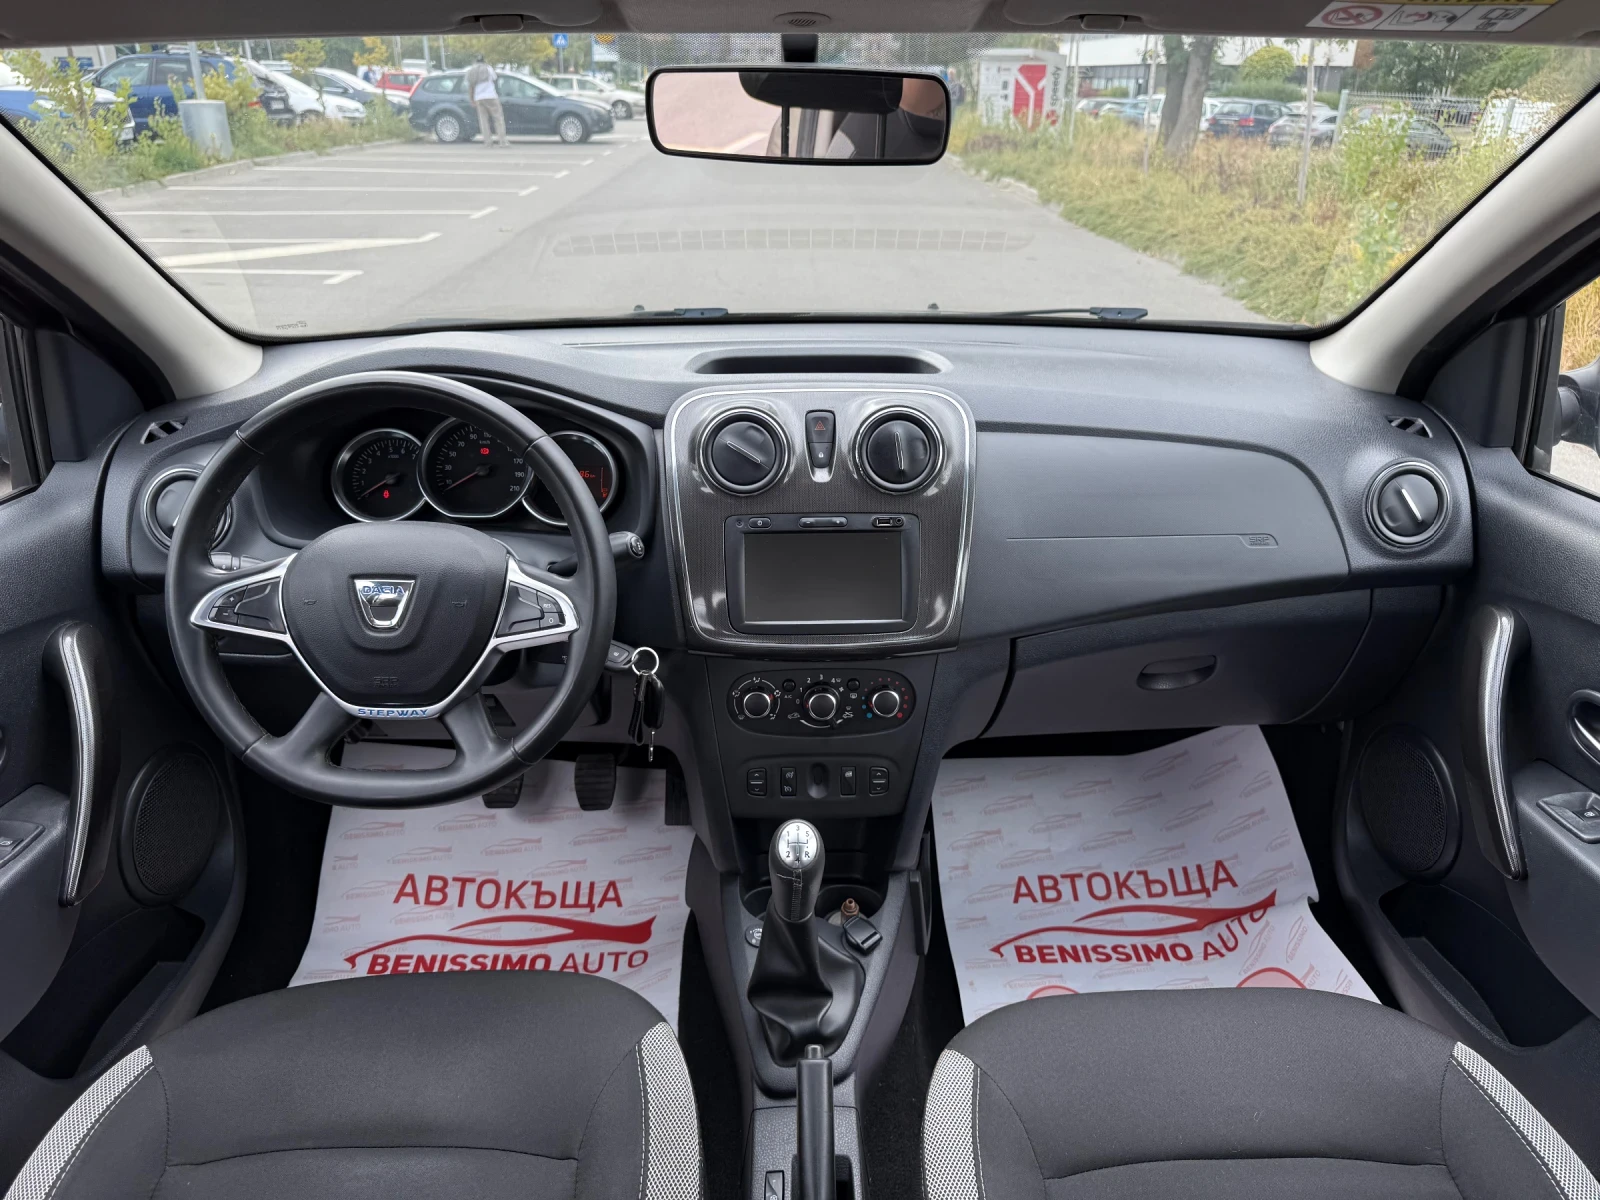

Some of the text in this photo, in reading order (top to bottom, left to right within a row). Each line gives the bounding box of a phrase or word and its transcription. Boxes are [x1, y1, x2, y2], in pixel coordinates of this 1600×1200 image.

[1050, 66, 1062, 107] speedy
[362, 586, 405, 594] DACIA
[358, 708, 428, 718] STEPWAY
[393, 873, 623, 912] АВТОКЪЩА
[1012, 859, 1239, 905] АВТОКЪЩА
[1013, 905, 1267, 964] BENISSIMO AUTO
[366, 950, 649, 975] BENISSIMO AUTO
